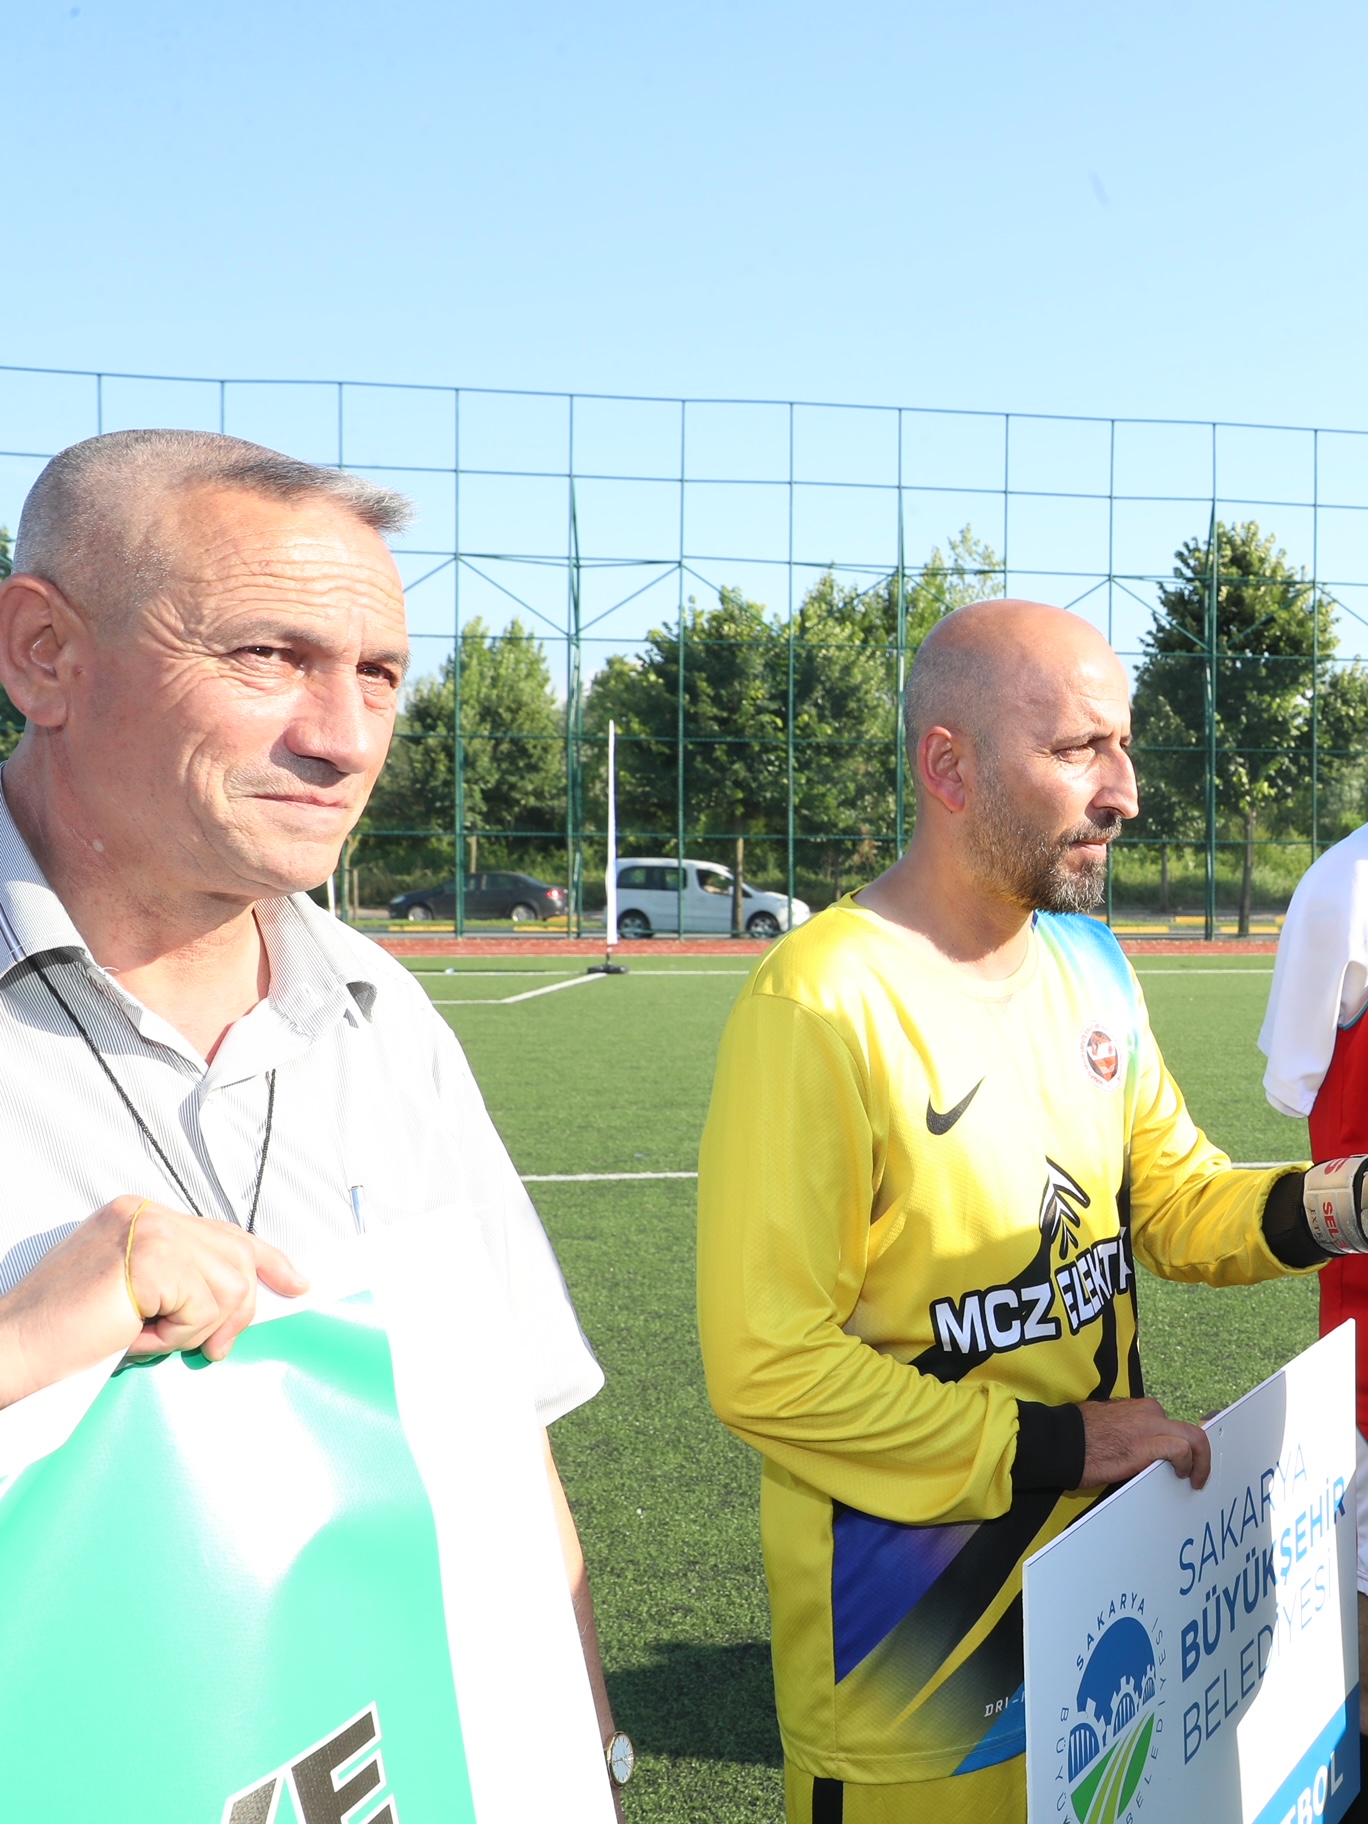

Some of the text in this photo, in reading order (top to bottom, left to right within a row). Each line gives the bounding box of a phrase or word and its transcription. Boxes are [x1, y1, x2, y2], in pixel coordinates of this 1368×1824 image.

[935, 1282, 1056, 1354] MCZ
[1178, 1442, 1308, 1597] SAKARYA
[1181, 1475, 1346, 1684] BÜYÜKŞEHİR
[1076, 1592, 1146, 1671] SAKARYA
[1183, 1546, 1332, 1766] BELEDİYESİ
